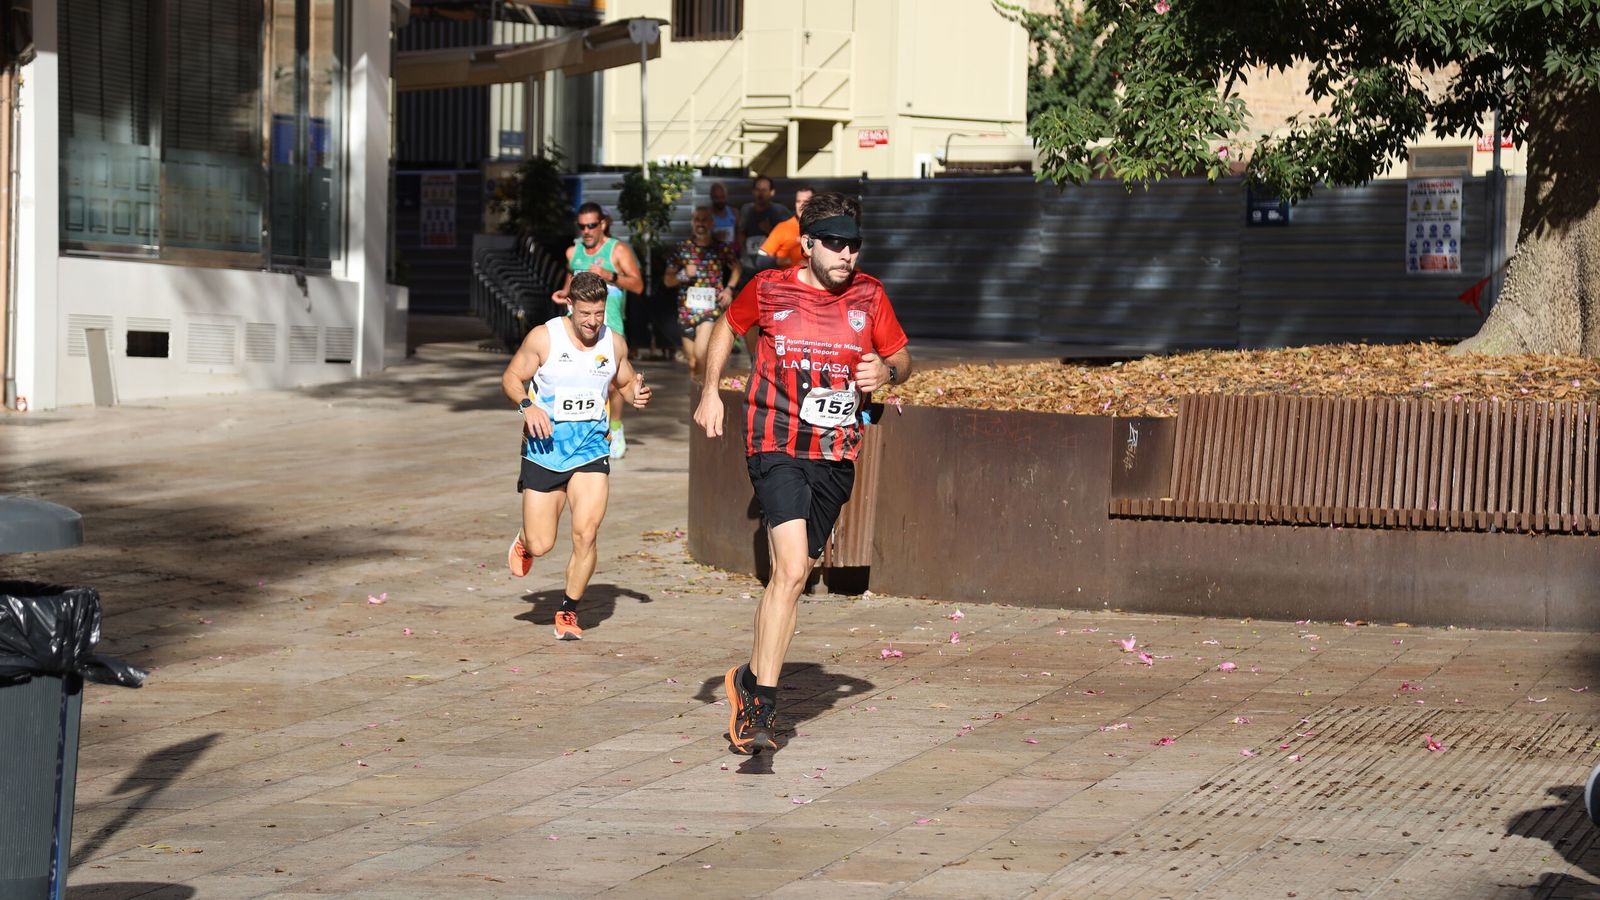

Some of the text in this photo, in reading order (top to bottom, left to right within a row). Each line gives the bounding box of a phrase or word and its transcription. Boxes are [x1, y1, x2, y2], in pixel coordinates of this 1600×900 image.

[786, 338, 832, 348] Ayuntamiento
[786, 345, 801, 353] Área
[812, 348, 839, 356] Deporte
[782, 359, 849, 374] LA CASA
[562, 399, 595, 411] 615
[815, 398, 855, 416] 152
